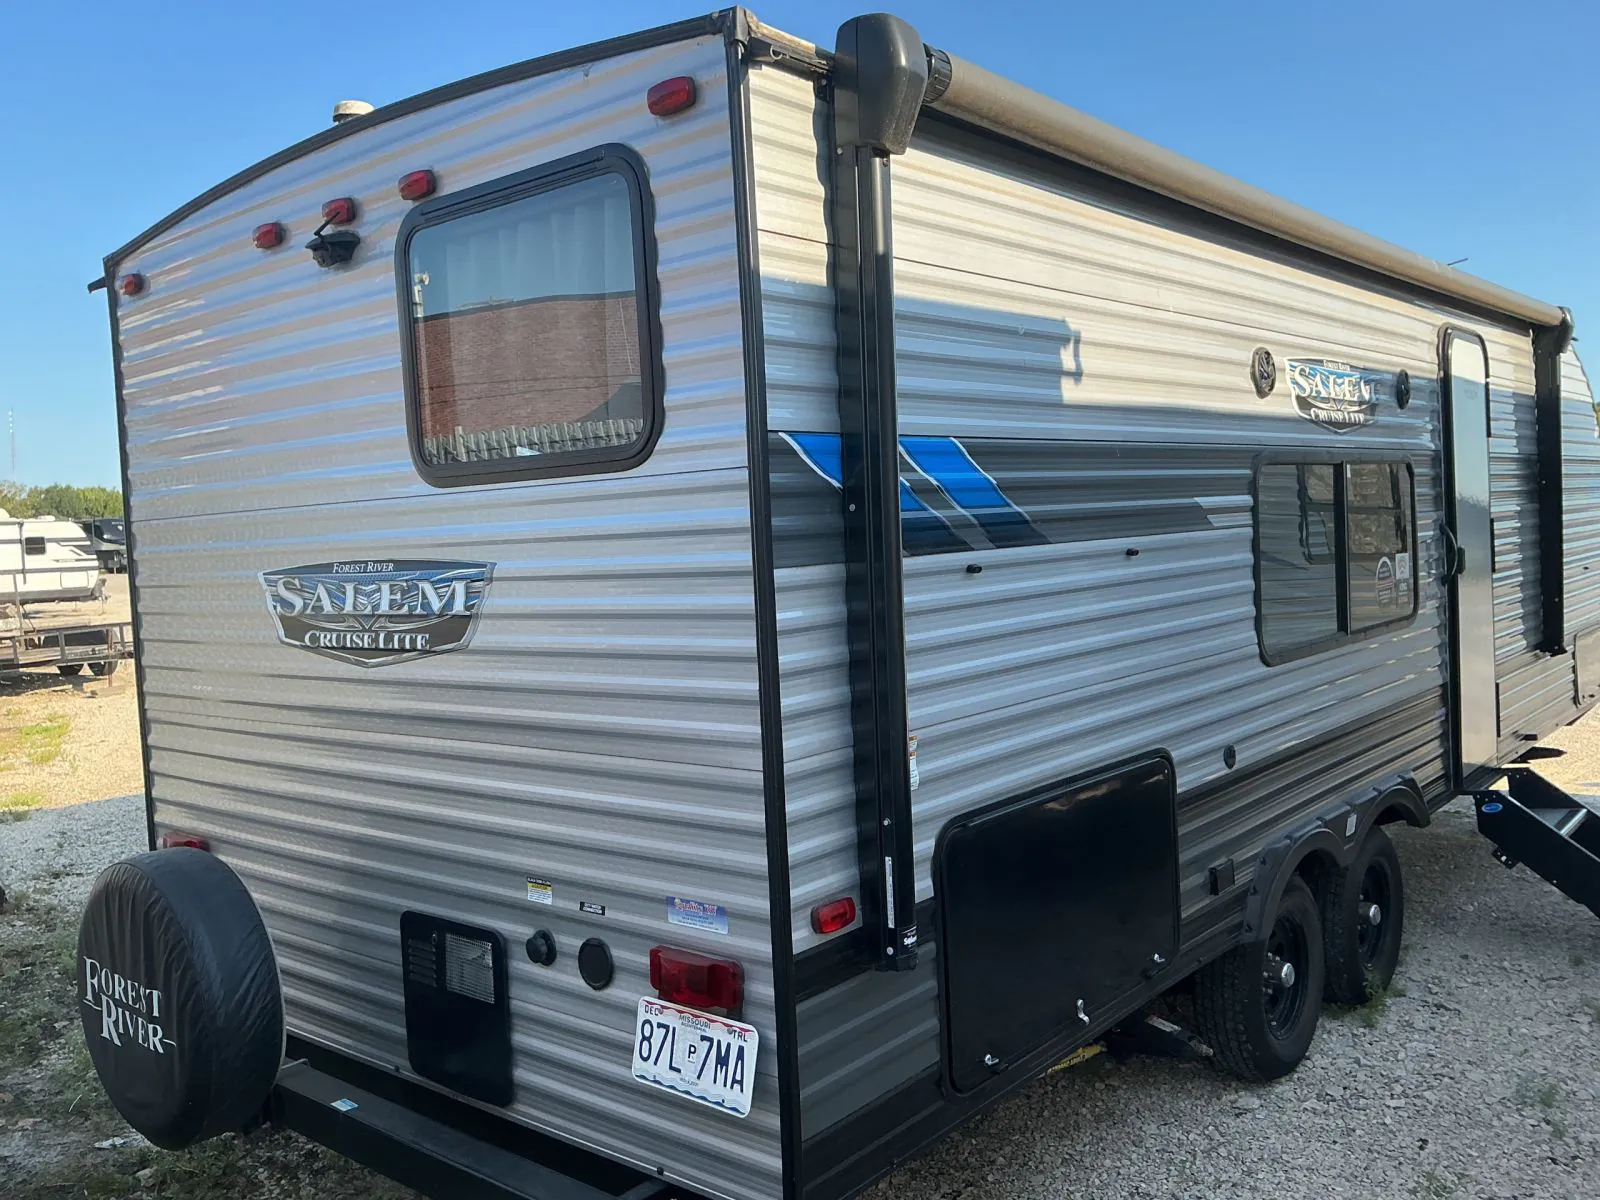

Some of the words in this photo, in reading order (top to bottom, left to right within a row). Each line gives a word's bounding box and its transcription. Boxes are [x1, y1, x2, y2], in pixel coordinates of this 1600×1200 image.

[333, 563, 366, 573] FOREST
[367, 562, 394, 572] RIVER
[276, 576, 473, 616] SALEM
[83, 956, 161, 1017] FOREST
[100, 993, 165, 1053] RIVER
[644, 1004, 659, 1016] DEC
[679, 1015, 711, 1029] MISSOURI
[733, 1029, 748, 1042] TRL
[639, 1019, 682, 1074] 87L
[687, 1044, 697, 1059] P
[697, 1034, 745, 1094] 7MA
